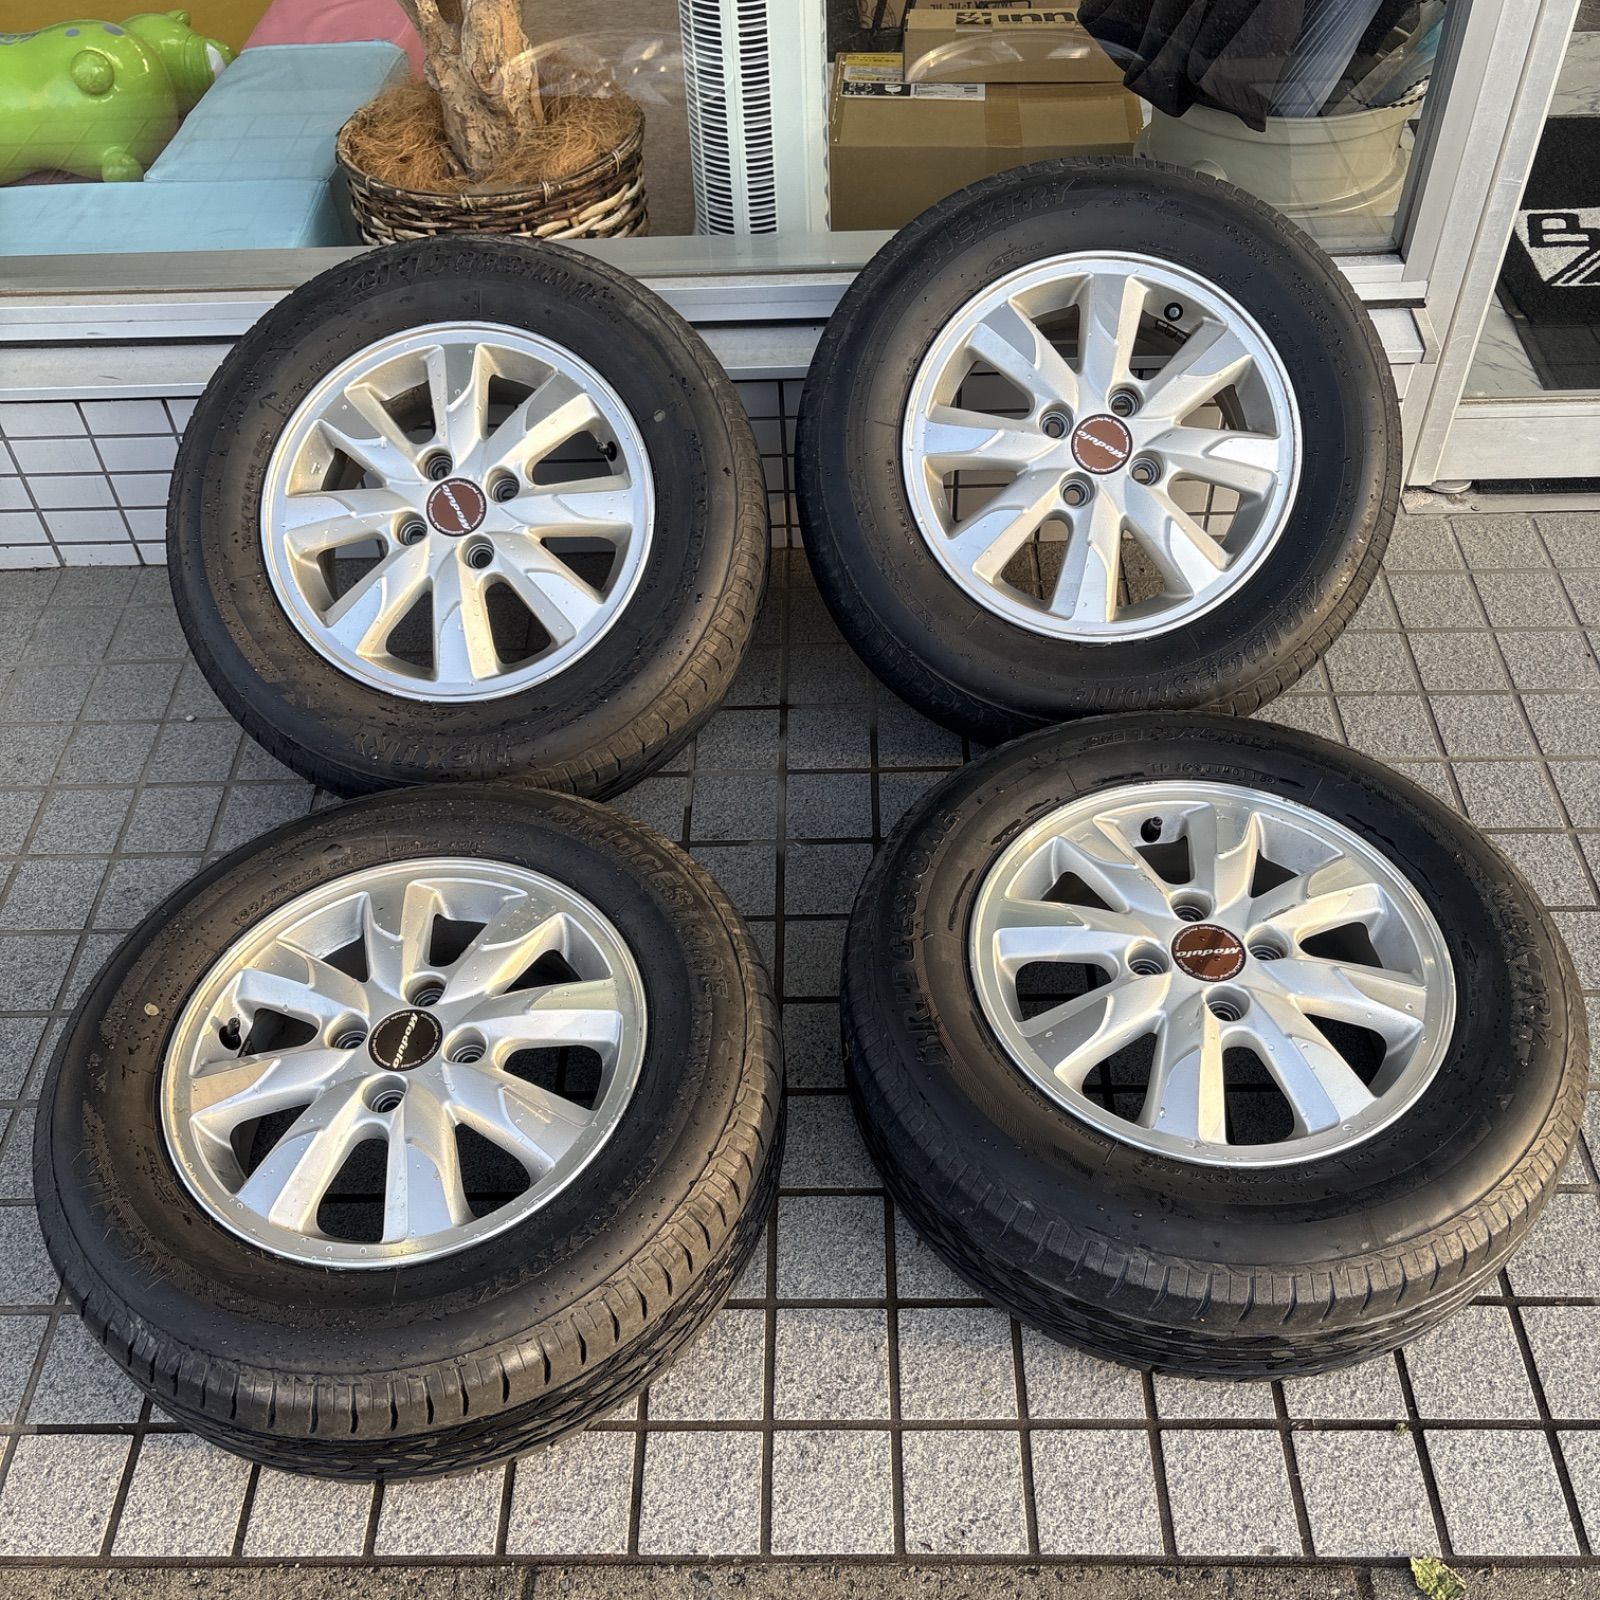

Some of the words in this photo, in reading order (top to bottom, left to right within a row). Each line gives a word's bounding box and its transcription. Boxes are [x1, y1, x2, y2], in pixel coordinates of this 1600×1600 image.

[998, 12, 1077, 22] inn
[1077, 430, 1127, 459] Modulo
[442, 484, 471, 530] Modulo
[1176, 946, 1243, 958] Modulo
[392, 1012, 419, 1068] Modulo
